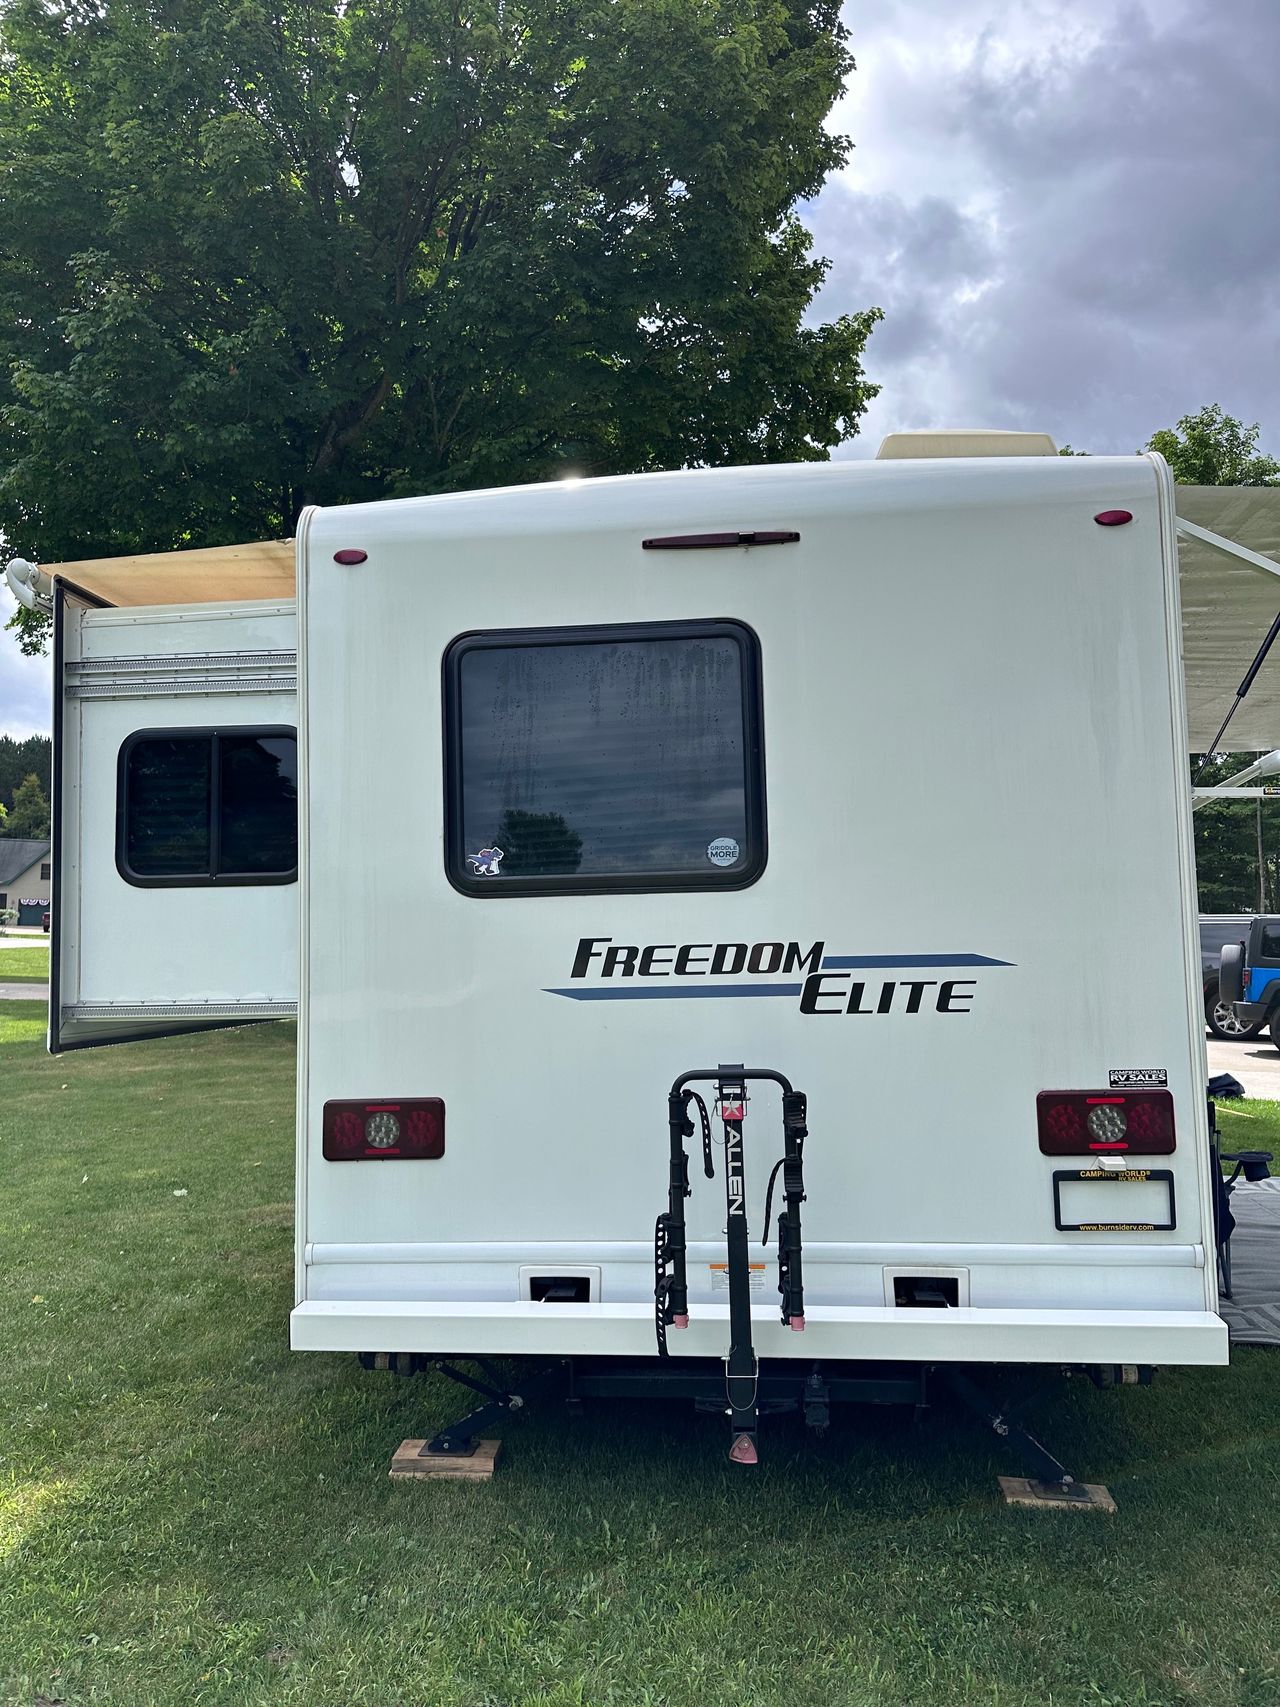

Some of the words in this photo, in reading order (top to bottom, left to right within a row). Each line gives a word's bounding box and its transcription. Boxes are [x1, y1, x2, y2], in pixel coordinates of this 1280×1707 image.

[710, 850, 738, 858] MORE
[570, 937, 825, 978] FREEDOM
[800, 973, 977, 1015] ELITE
[1129, 1073, 1166, 1081] SALES
[726, 1125, 743, 1216] ALLEN
[1079, 1223, 1155, 1231] www.burnsiderv.com
